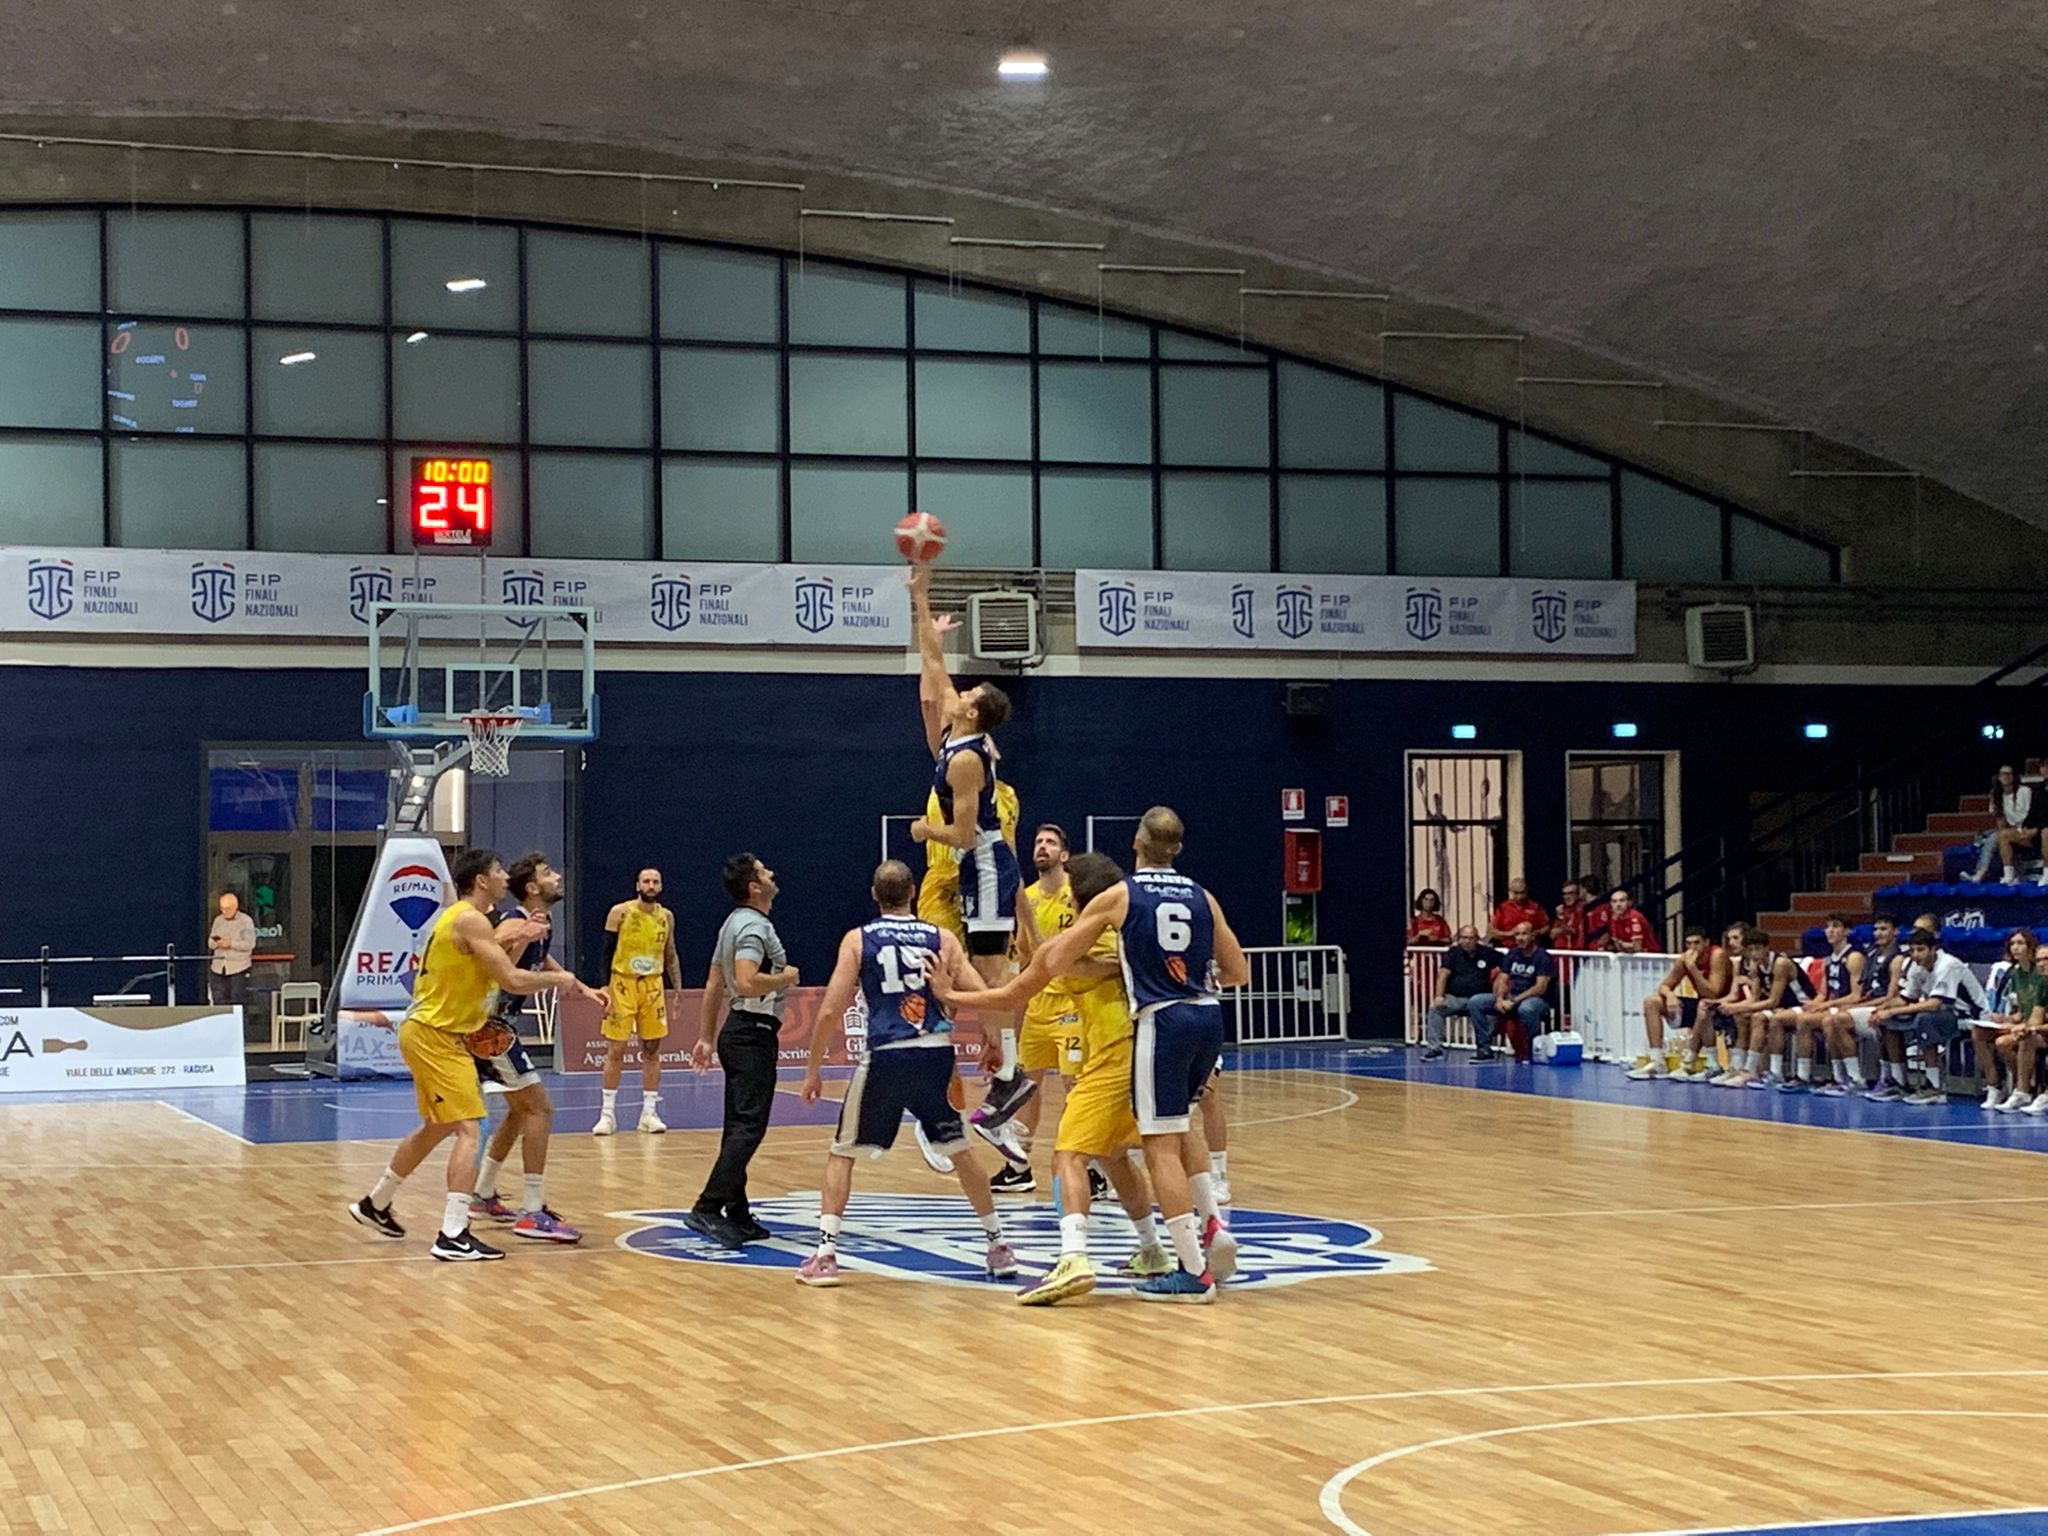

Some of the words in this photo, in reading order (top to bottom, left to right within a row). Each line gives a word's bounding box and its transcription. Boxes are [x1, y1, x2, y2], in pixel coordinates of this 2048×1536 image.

[424, 461, 488, 483] 10:00
[419, 485, 485, 529] 24
[83, 571, 121, 582] FIP
[245, 574, 281, 585] FIP
[402, 578, 437, 589] FIP
[553, 581, 587, 592] FIP
[83, 586, 117, 597] FINALI
[245, 589, 277, 601] FINALI
[700, 585, 732, 596] FIP
[842, 587, 874, 598] FIP
[1144, 591, 1174, 602] FIP
[700, 598, 729, 610] FINALI
[1320, 594, 1350, 605] FIP
[1450, 597, 1478, 608] FIP
[1573, 600, 1602, 611] FIP
[83, 601, 138, 614] NAZIONALI
[245, 603, 299, 617] NAZIONALI
[842, 602, 870, 613] FINALI
[1144, 605, 1171, 616] FINALI
[700, 613, 748, 626] NAZIONALI
[1320, 608, 1347, 620] FINALI
[842, 616, 889, 628] NAZIONALI
[1144, 619, 1189, 631] NAZIONALI
[1320, 622, 1365, 634] NAZIONALI
[393, 881, 436, 894] RE/MAX
[1057, 913, 1074, 929] 12
[1155, 902, 1192, 951] 6
[1065, 1037, 1081, 1050] 12
[90, 1067, 113, 1077] DELLE
[161, 1065, 176, 1075] 272
